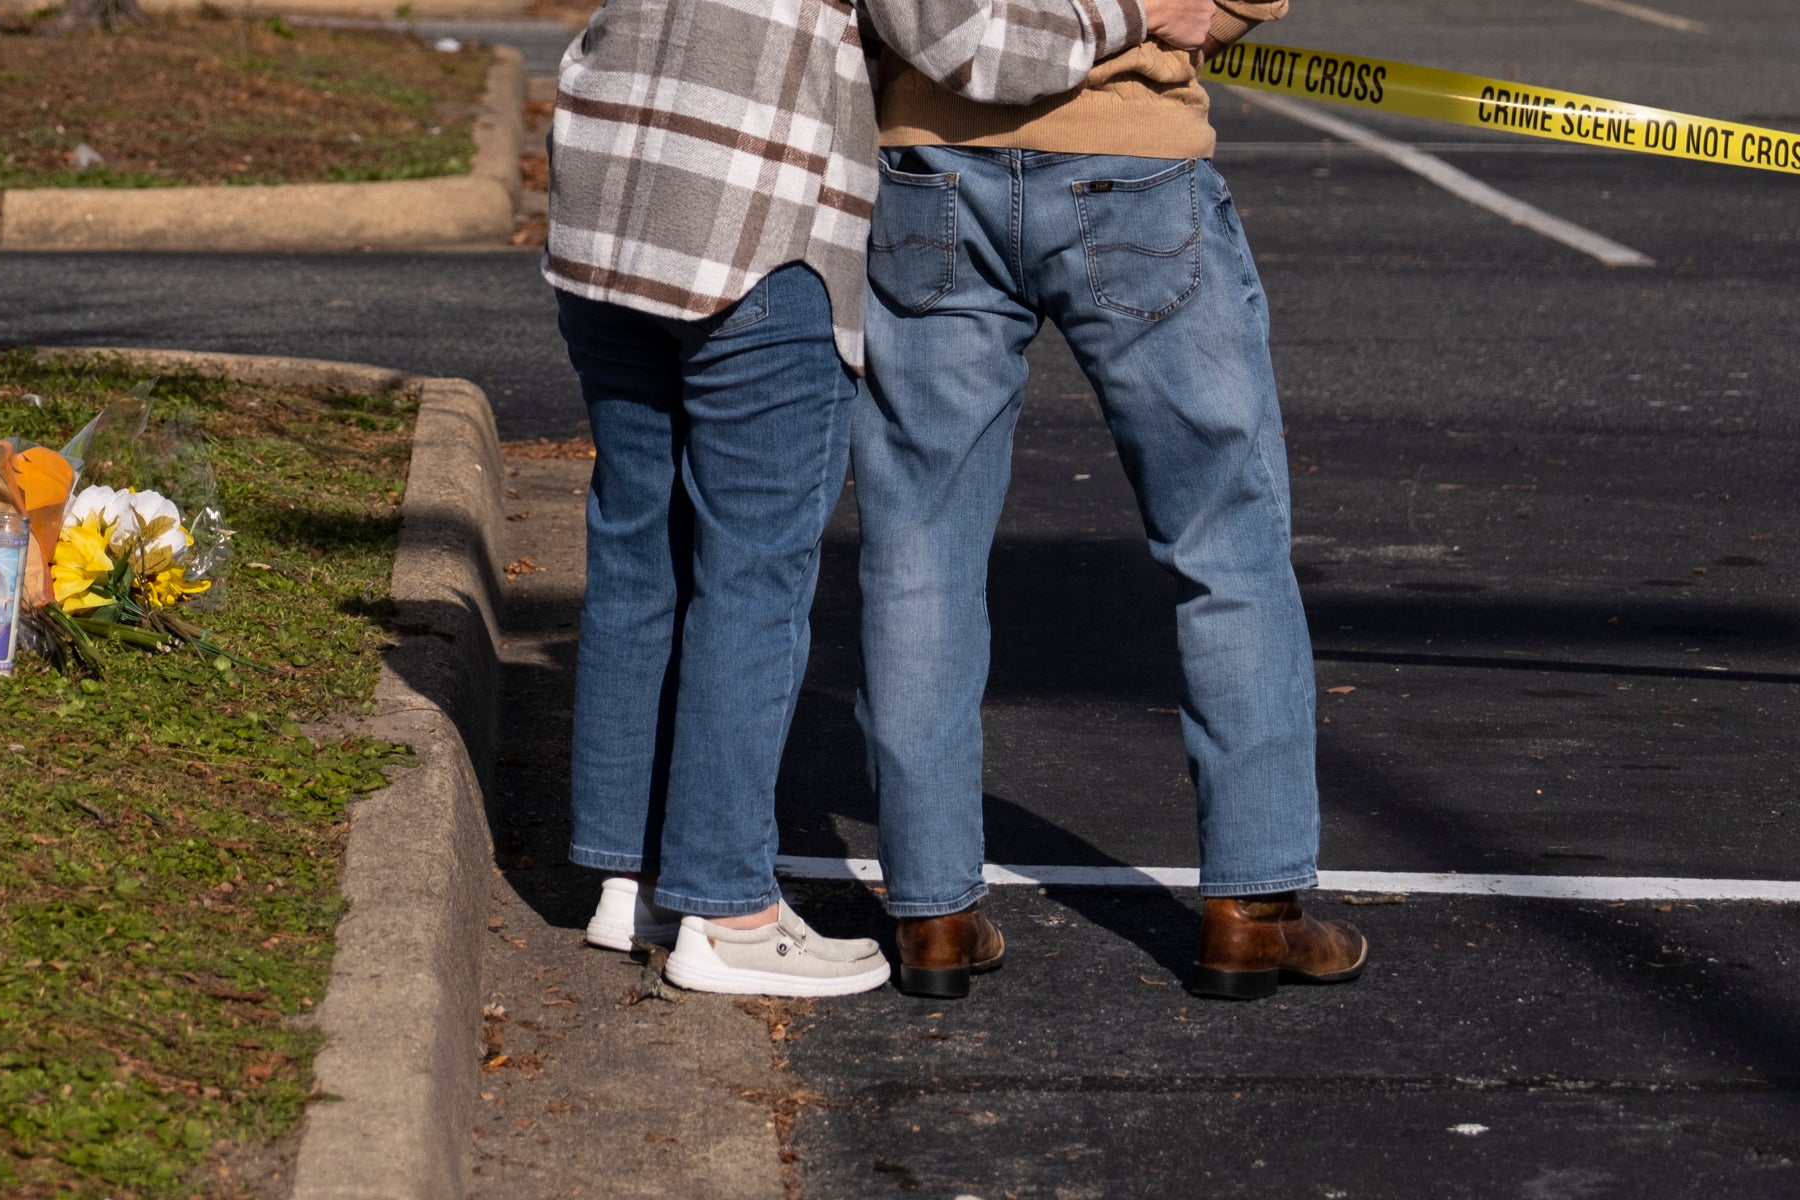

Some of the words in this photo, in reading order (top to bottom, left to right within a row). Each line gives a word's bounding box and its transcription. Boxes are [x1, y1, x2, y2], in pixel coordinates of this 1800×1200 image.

[1209, 43, 1245, 78] DO
[1250, 46, 1302, 88] NOT
[1305, 55, 1387, 104] CROSS
[1478, 86, 1555, 133] CRIME
[1561, 100, 1636, 145] SCENE
[1644, 118, 1678, 151] DO
[1686, 123, 1734, 159] NOT
